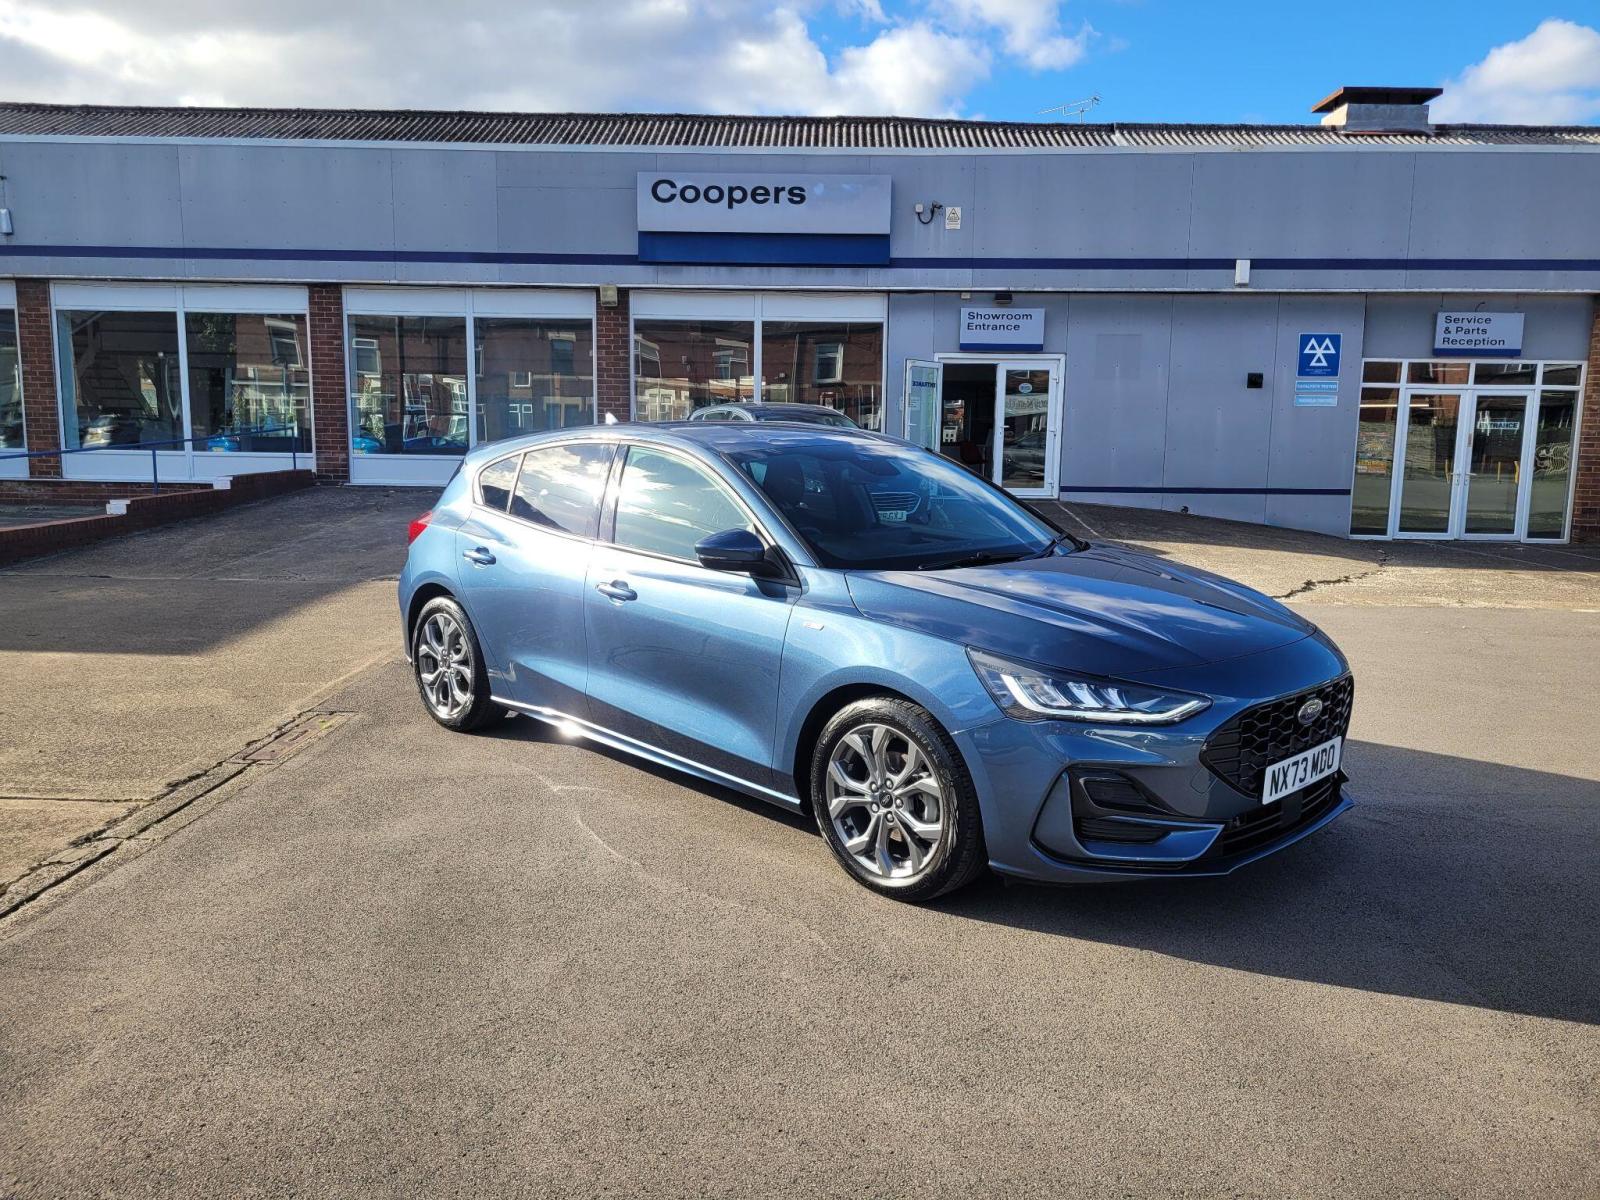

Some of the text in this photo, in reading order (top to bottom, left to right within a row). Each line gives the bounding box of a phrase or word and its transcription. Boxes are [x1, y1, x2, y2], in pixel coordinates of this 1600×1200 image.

[651, 179, 807, 210] Coopers
[967, 311, 1033, 321] Showroom
[1444, 315, 1492, 324] Service
[967, 322, 1021, 331] Entrance
[1443, 326, 1488, 335] & Parts
[1442, 337, 1506, 347] Reception
[1269, 744, 1336, 797] NX73 MDO
